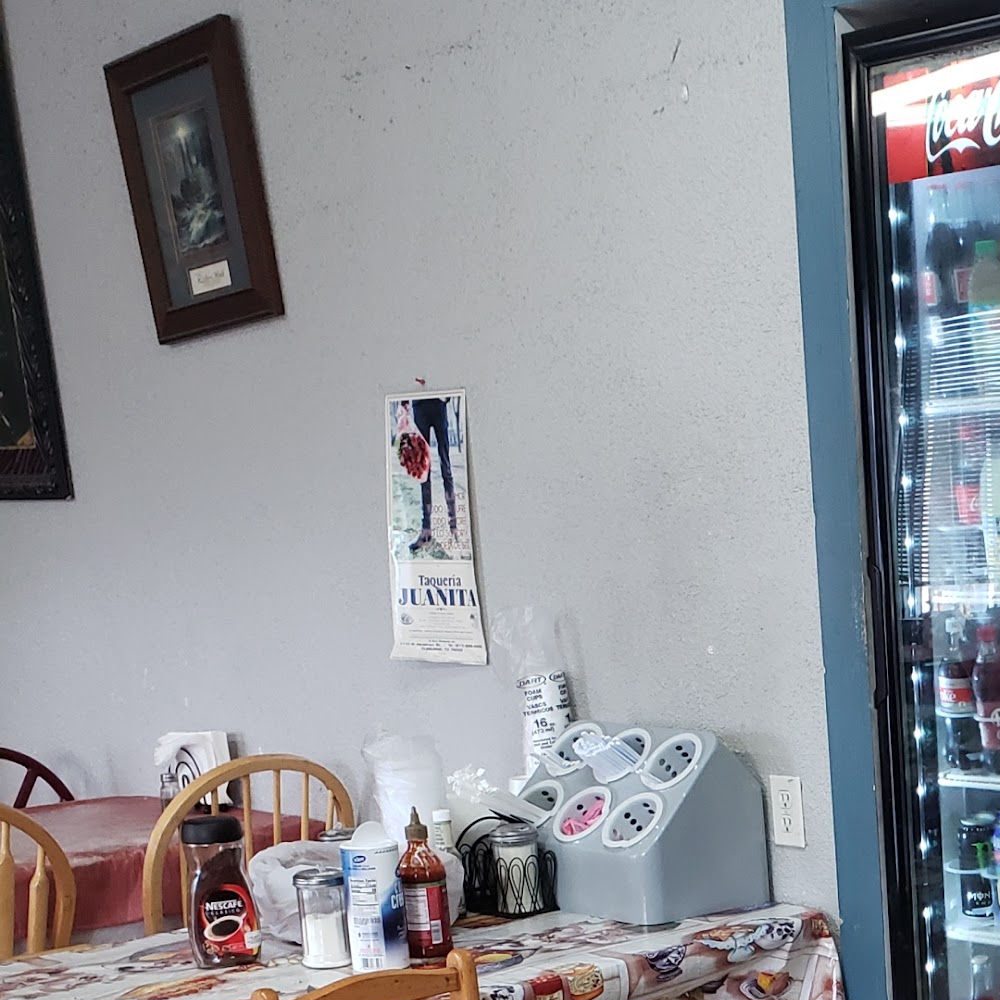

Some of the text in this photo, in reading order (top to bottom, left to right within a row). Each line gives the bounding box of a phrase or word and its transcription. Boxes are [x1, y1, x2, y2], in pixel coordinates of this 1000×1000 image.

[398, 588, 477, 607] JUANITA
[519, 677, 541, 687] DART
[524, 688, 542, 696] FOAM
[526, 694, 543, 702] CUPS
[534, 718, 548, 728] 16
